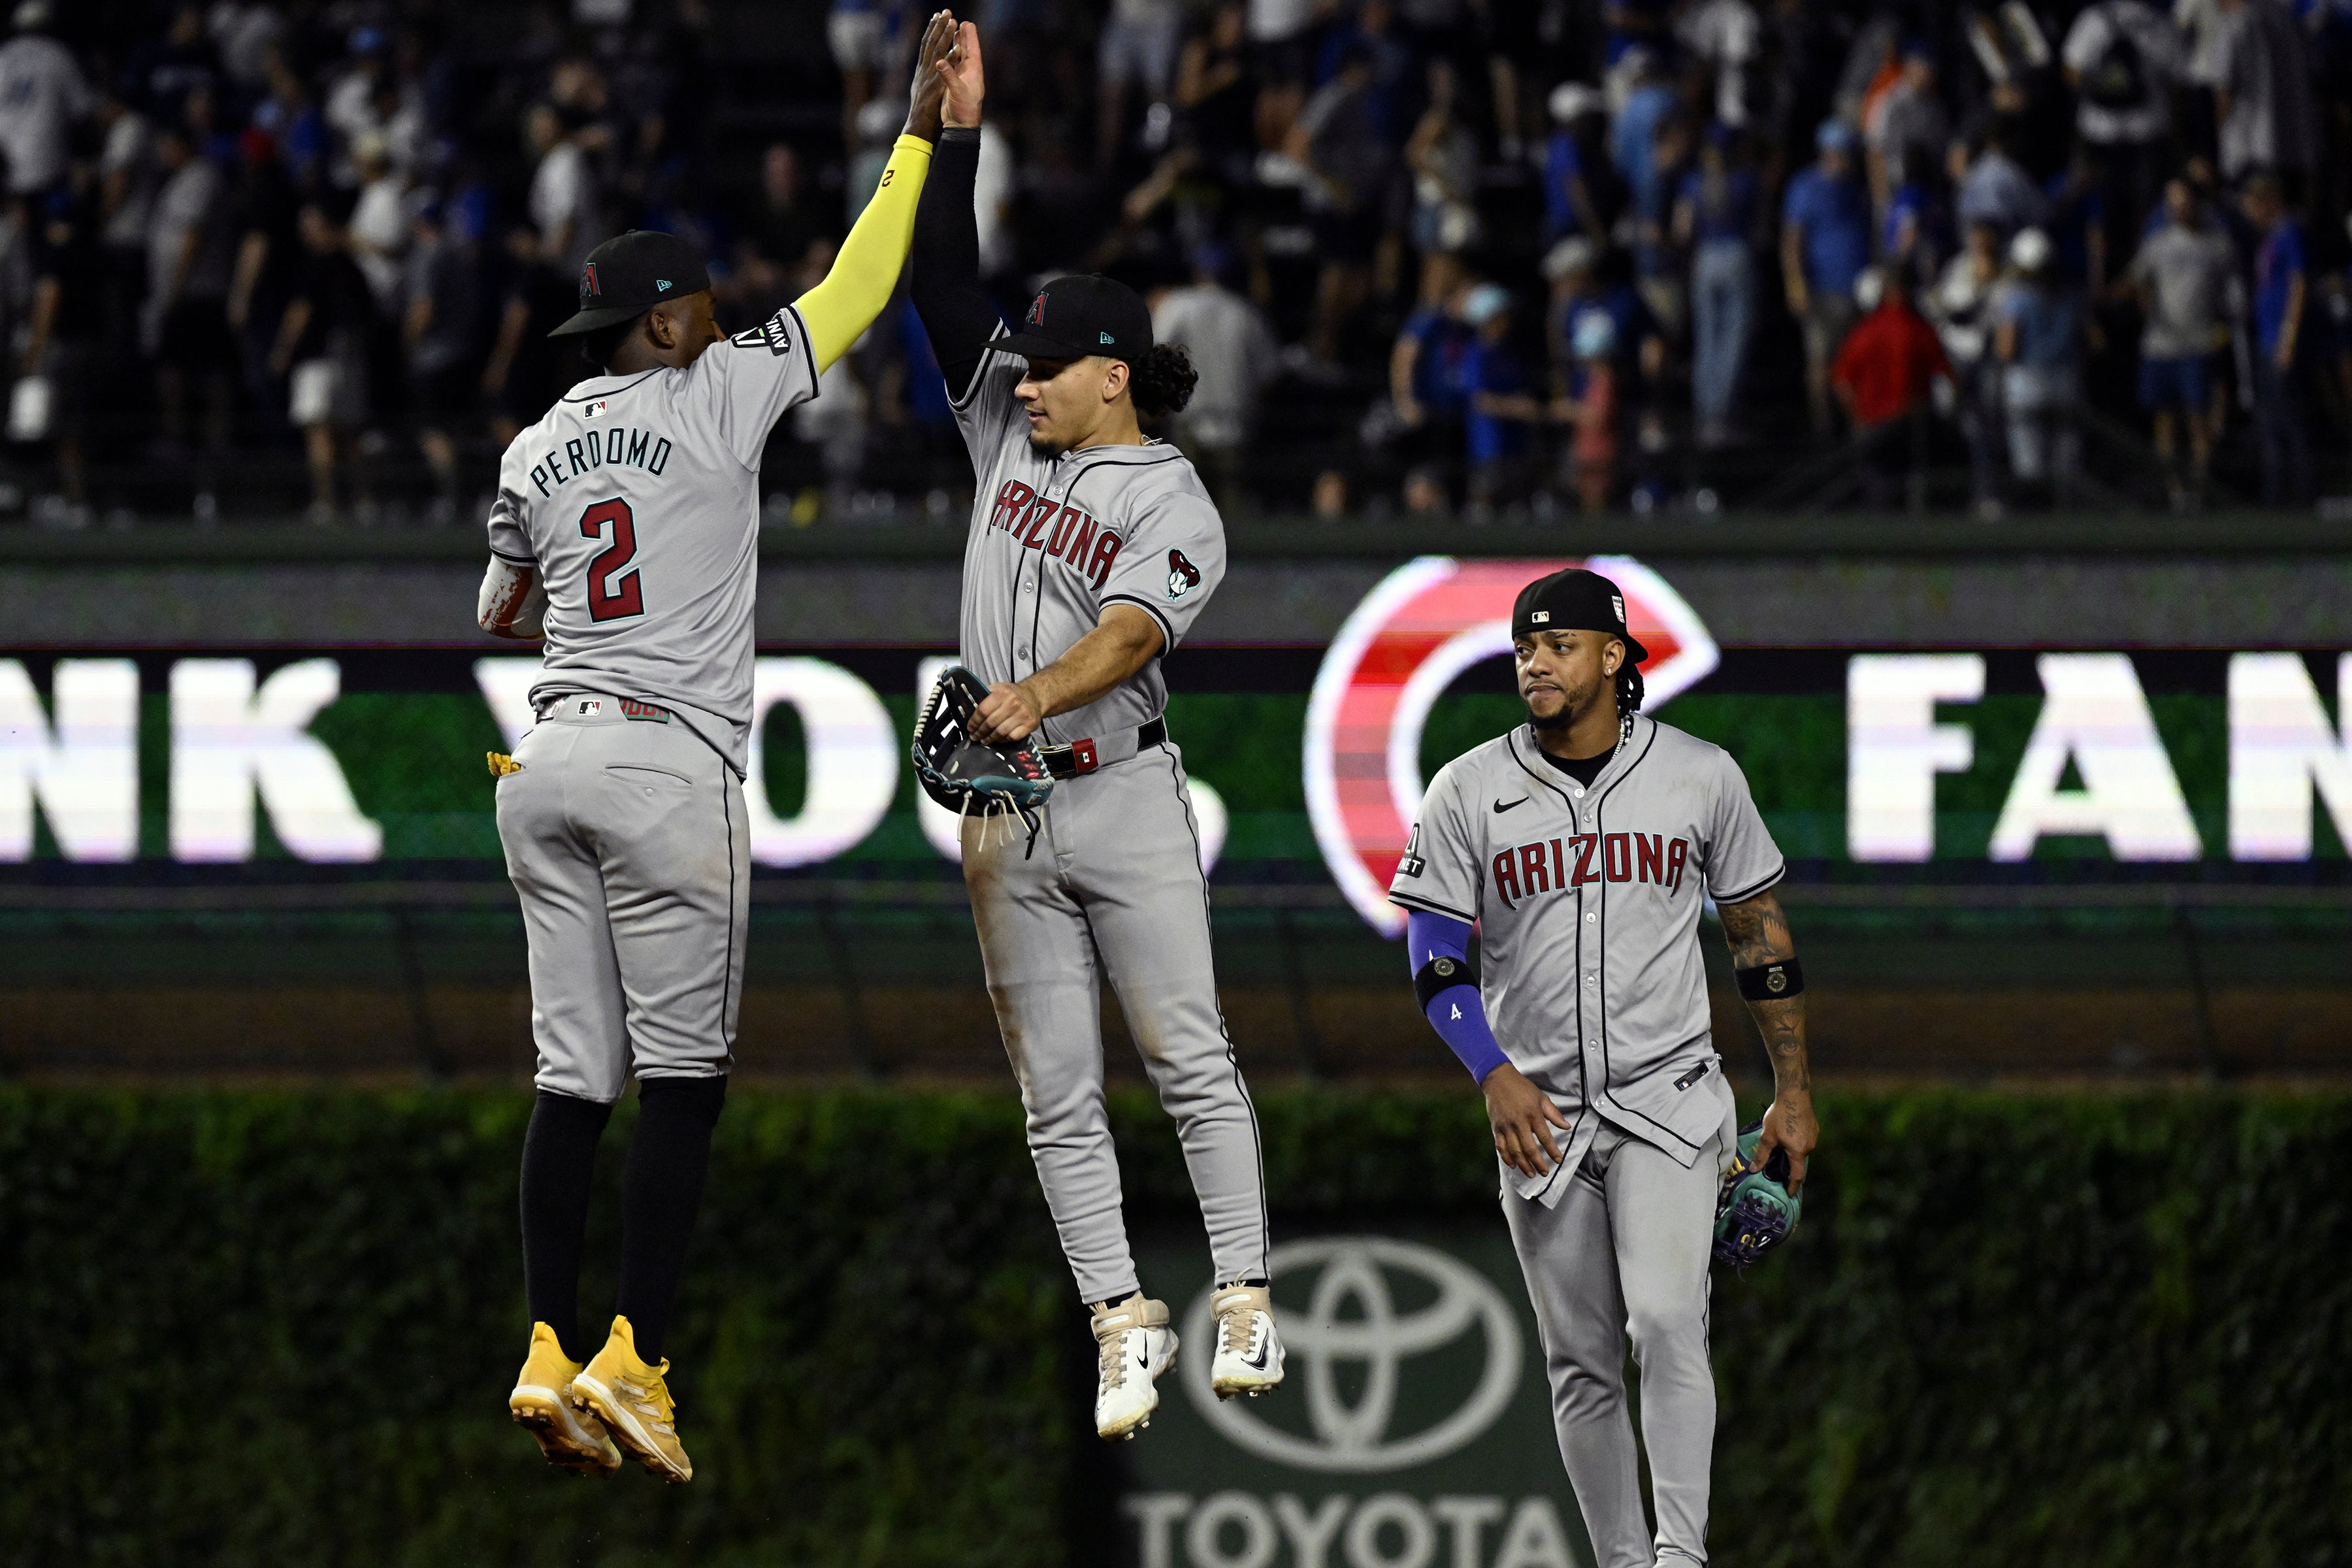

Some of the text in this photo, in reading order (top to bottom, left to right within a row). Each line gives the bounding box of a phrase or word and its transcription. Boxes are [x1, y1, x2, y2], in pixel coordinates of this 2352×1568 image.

[882, 170, 895, 188] 2
[530, 428, 672, 498] PERDOMO
[578, 495, 647, 625] 2
[987, 478, 1123, 592] ARIZONA
[1846, 653, 2352, 862] FAN
[1492, 831, 1688, 911] ARIZONA
[1450, 1003, 1463, 1021] 4
[1121, 1491, 1576, 1568] TOYOTA
